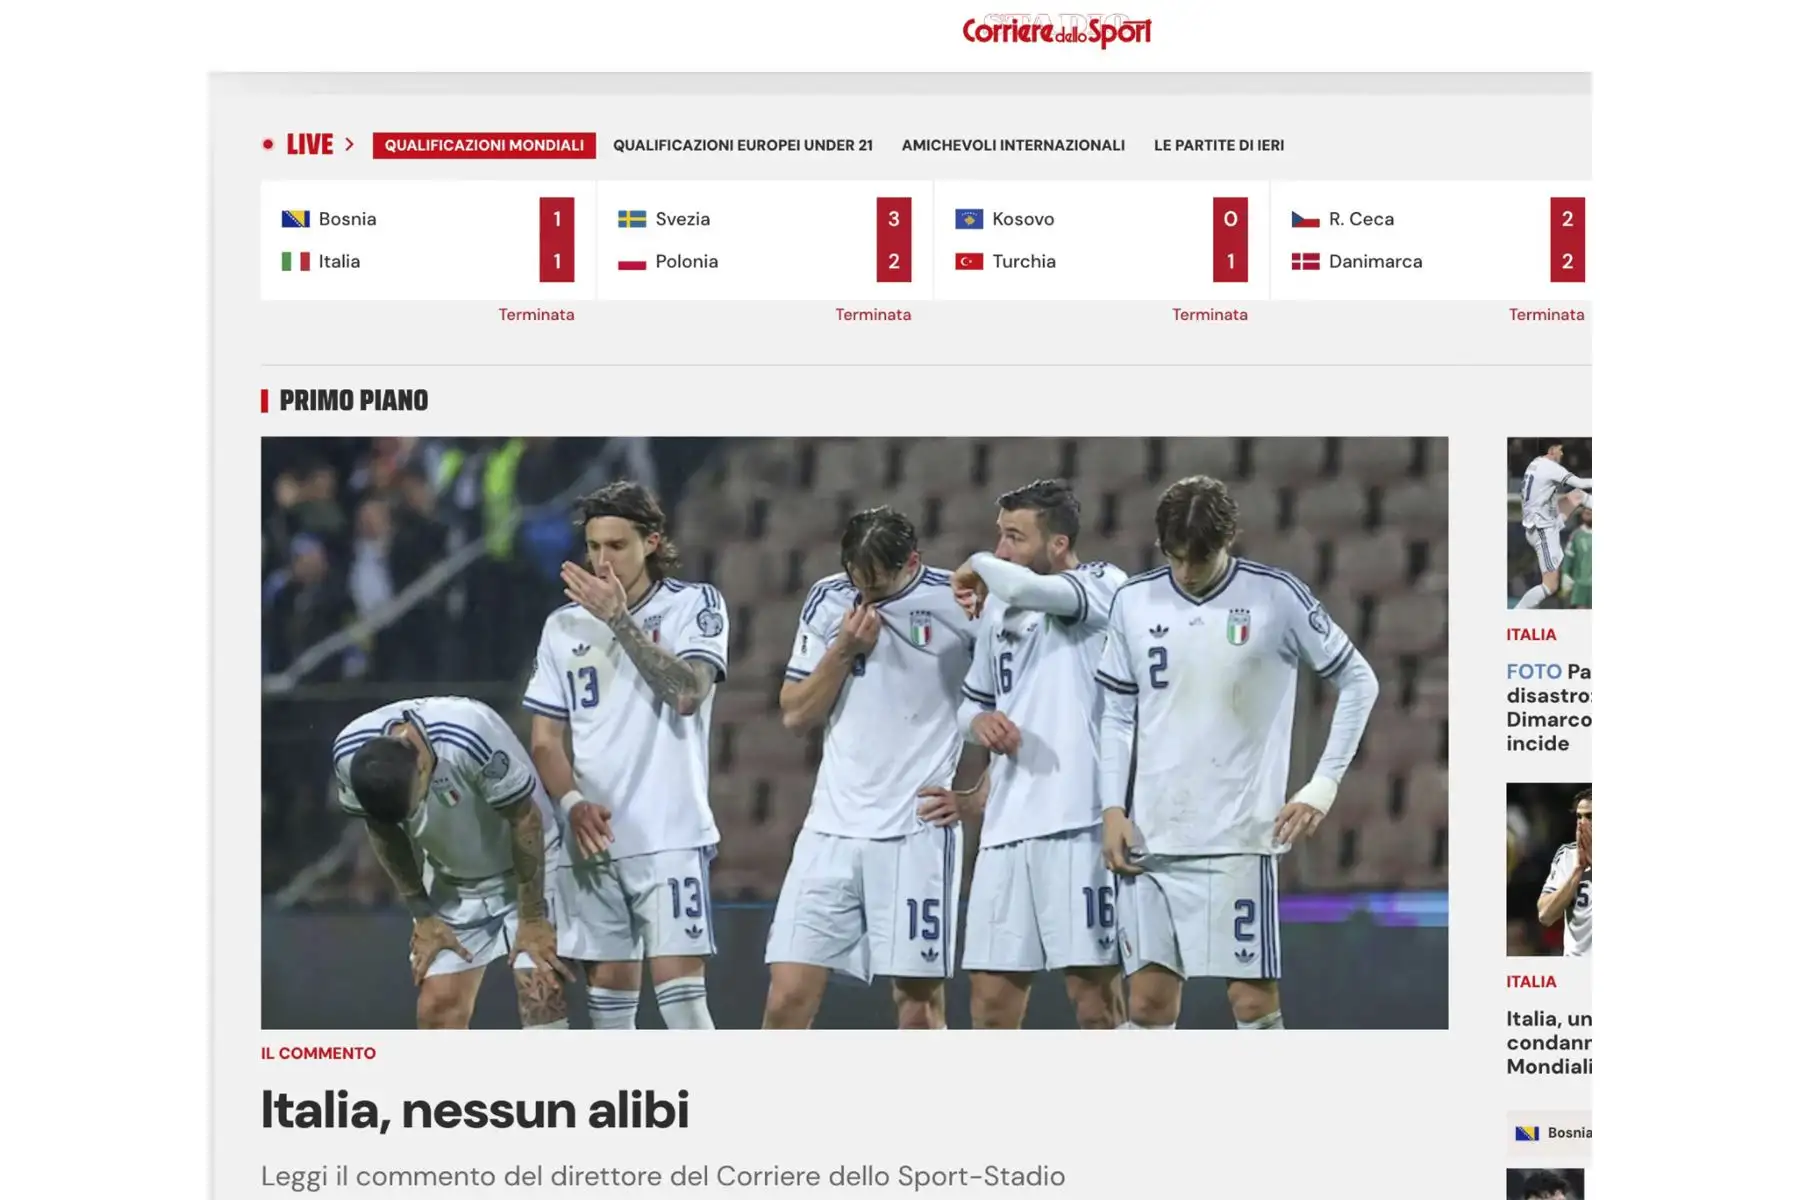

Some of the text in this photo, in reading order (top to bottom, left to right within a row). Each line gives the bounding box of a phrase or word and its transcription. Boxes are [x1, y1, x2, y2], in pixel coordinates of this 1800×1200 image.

[962, 18, 1152, 50] Corriere dello Sport
[286, 132, 335, 155] LIVE
[384, 139, 584, 153] QUALIFICAZIONI MONDIALI
[612, 138, 873, 153] QUALIFICAZIONI EUROPEI UNDER 21
[901, 138, 1126, 152] AMICHEVOLI INTERNAZIONALI
[1154, 138, 1285, 152] LE PARTITE DI IERI
[319, 211, 377, 227] Bosnia
[553, 210, 561, 227] 1
[655, 211, 711, 227] Svezia
[888, 210, 900, 227] 3
[992, 211, 1056, 227] Kosovo
[1223, 210, 1238, 227] 0
[1329, 211, 1395, 227] R. Ceca
[1561, 210, 1574, 227] 2
[319, 252, 361, 269] Italia
[553, 253, 561, 270] 1
[655, 252, 719, 269] Polonia
[888, 252, 900, 270] 2
[992, 252, 1056, 269] Turchia
[1226, 252, 1235, 270] 1
[1329, 252, 1423, 269] Danimarca
[1561, 252, 1574, 270] 2
[498, 307, 576, 322] Terminata
[835, 307, 912, 322] Terminata
[1172, 307, 1249, 322] Terminata
[1508, 307, 1586, 322] Terminata
[279, 388, 429, 412] PRIMO PIANO
[1506, 627, 1558, 642] ITALIA
[1148, 646, 1170, 690] 2
[1506, 663, 1592, 680] FOTO Pa
[566, 664, 600, 709] 13
[1506, 711, 1592, 728] Dimarco
[1506, 734, 1570, 752] incide
[668, 876, 702, 919] 13
[1082, 886, 1115, 929] 16
[906, 898, 940, 941] 15
[1234, 899, 1256, 942] 2
[1506, 974, 1558, 989] ITALIA
[1506, 1010, 1592, 1029] Italia, un
[260, 1046, 377, 1061] IL COMMENTO
[1506, 1058, 1592, 1075] Mondiali
[262, 1089, 690, 1136] Italia, nessun alibi
[1548, 1126, 1592, 1140] Bosnia
[261, 1164, 1066, 1193] Leggi il commento del direttore del Corriere dello Sport-Stadio
